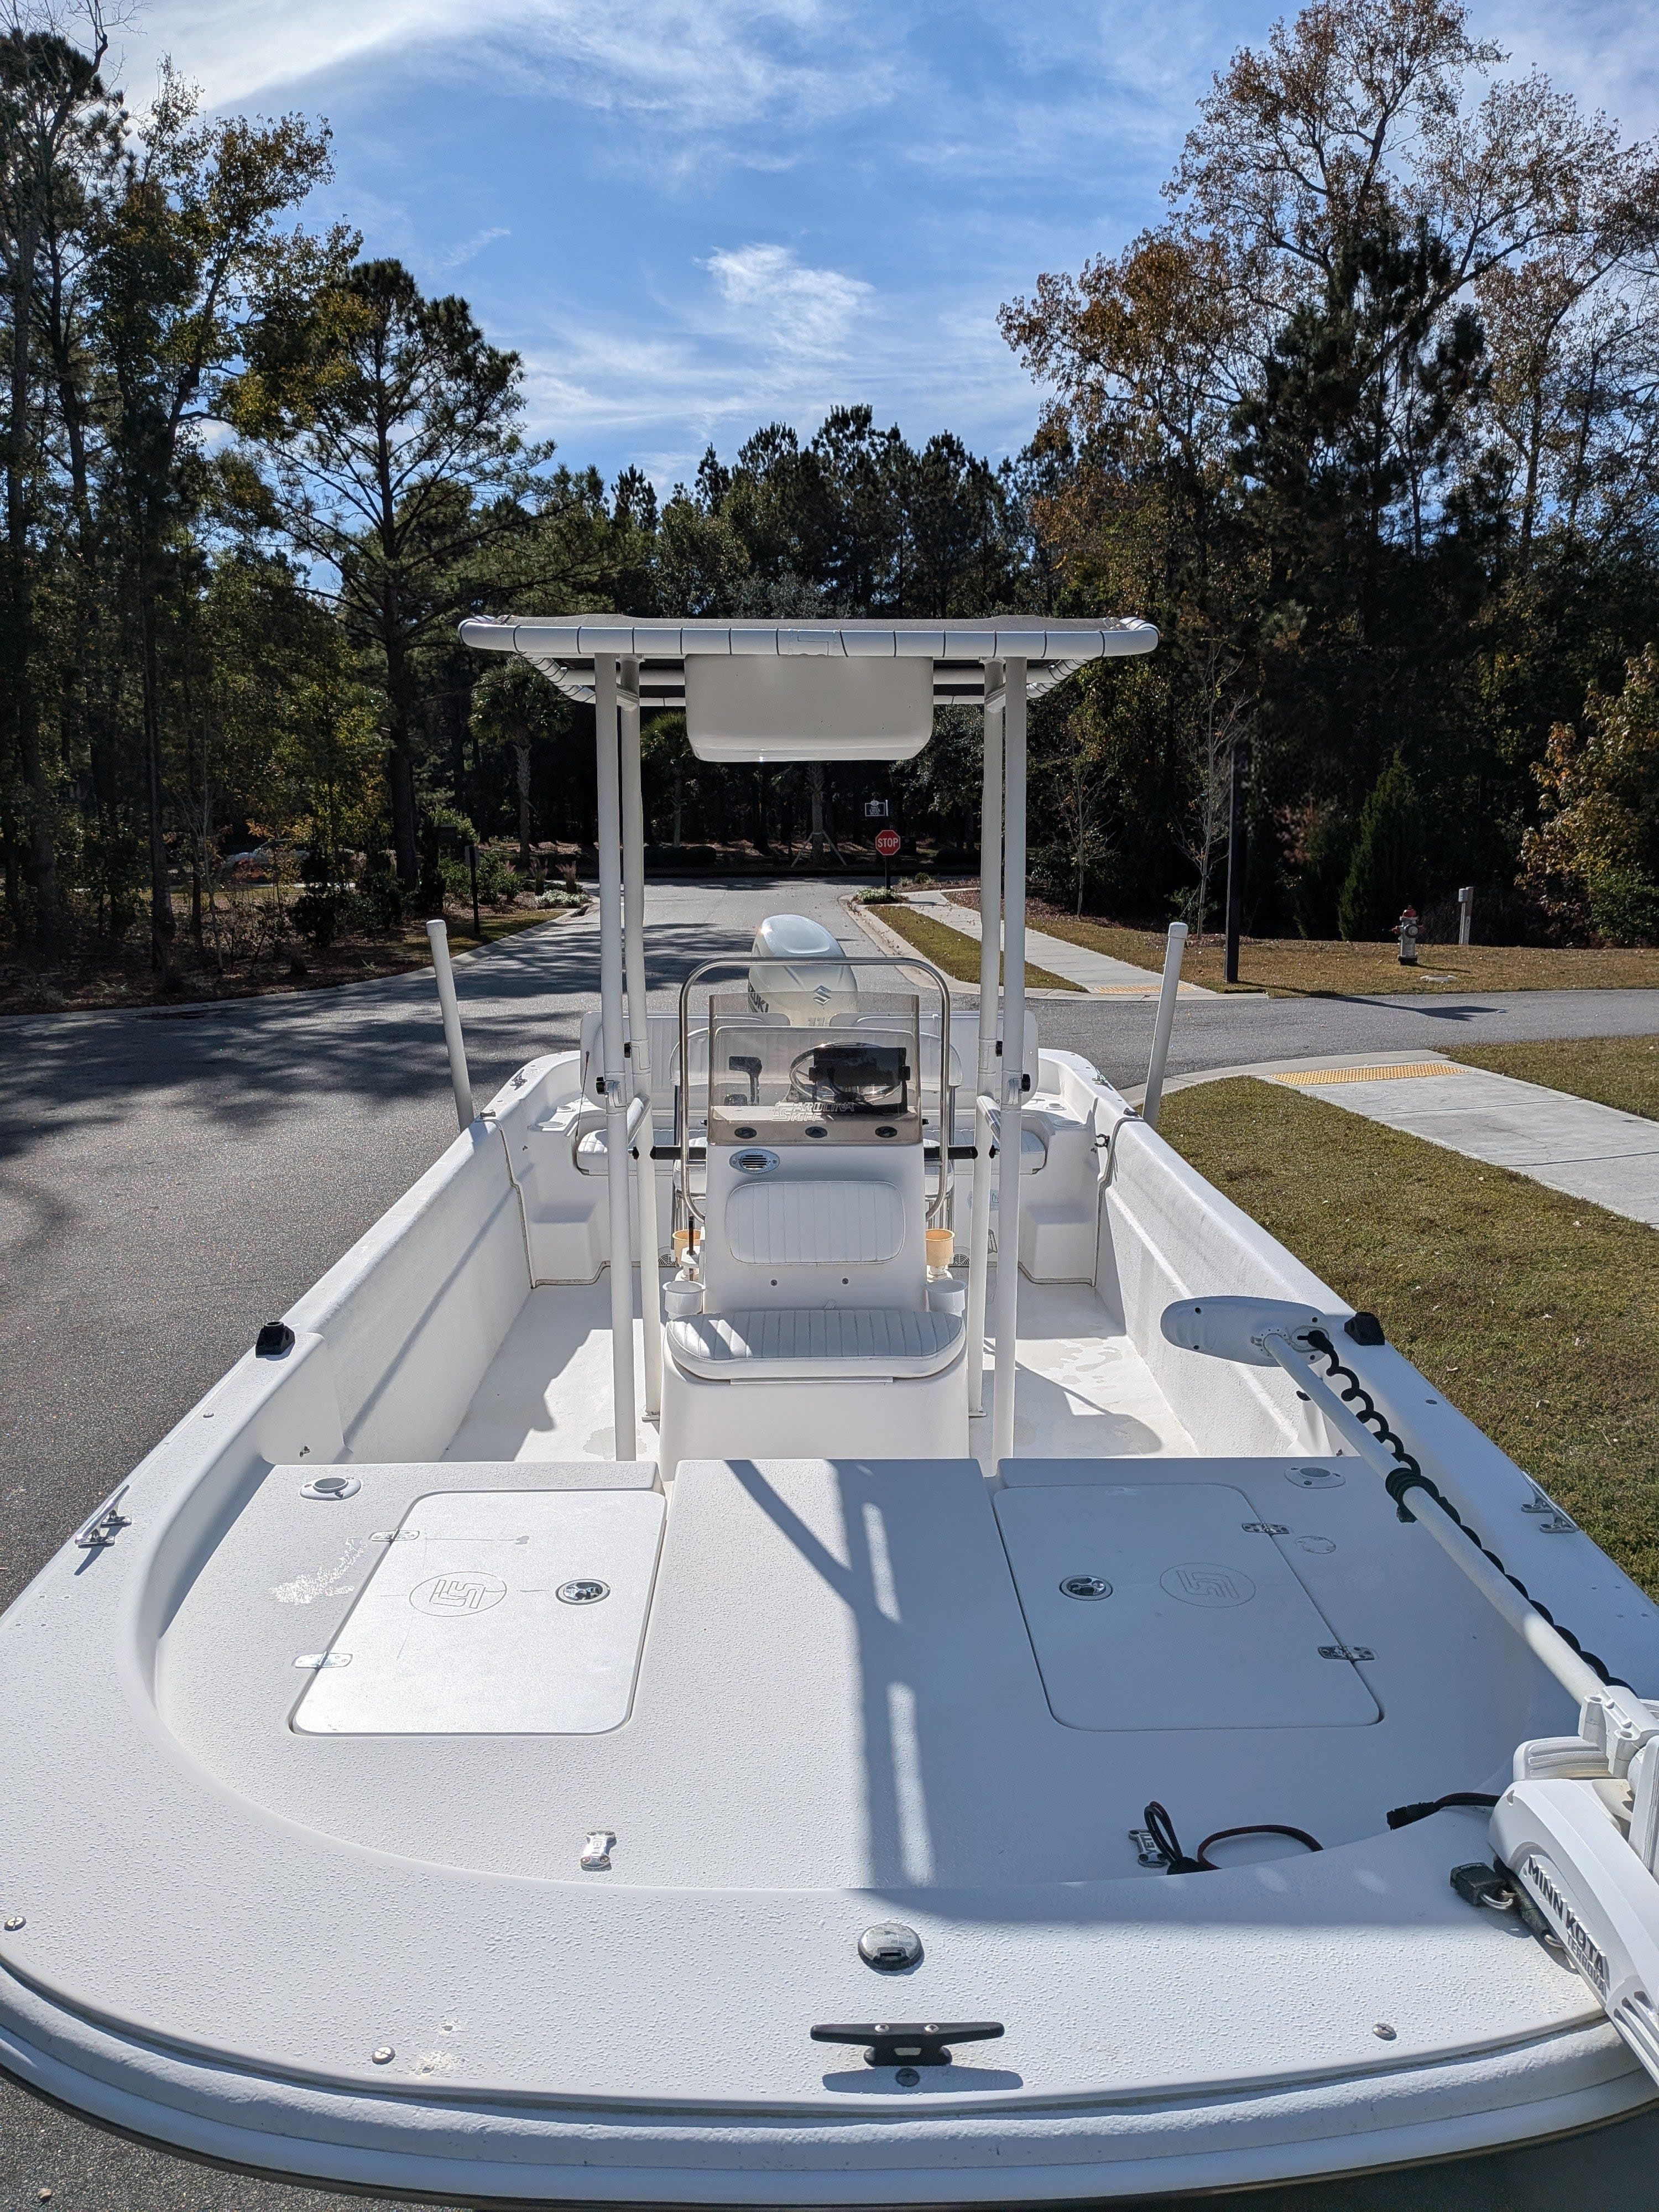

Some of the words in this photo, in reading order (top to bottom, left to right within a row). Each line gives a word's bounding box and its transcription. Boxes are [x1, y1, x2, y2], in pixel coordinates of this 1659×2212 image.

[878, 838, 899, 848] STOP
[774, 1102, 855, 1114] CAROLINA
[1140, 1834, 1158, 1854] YETI
[1528, 1854, 1568, 1922] MINN
[1566, 1907, 1610, 1991] KOTA
[1567, 1929, 1608, 2001] TERROVA
